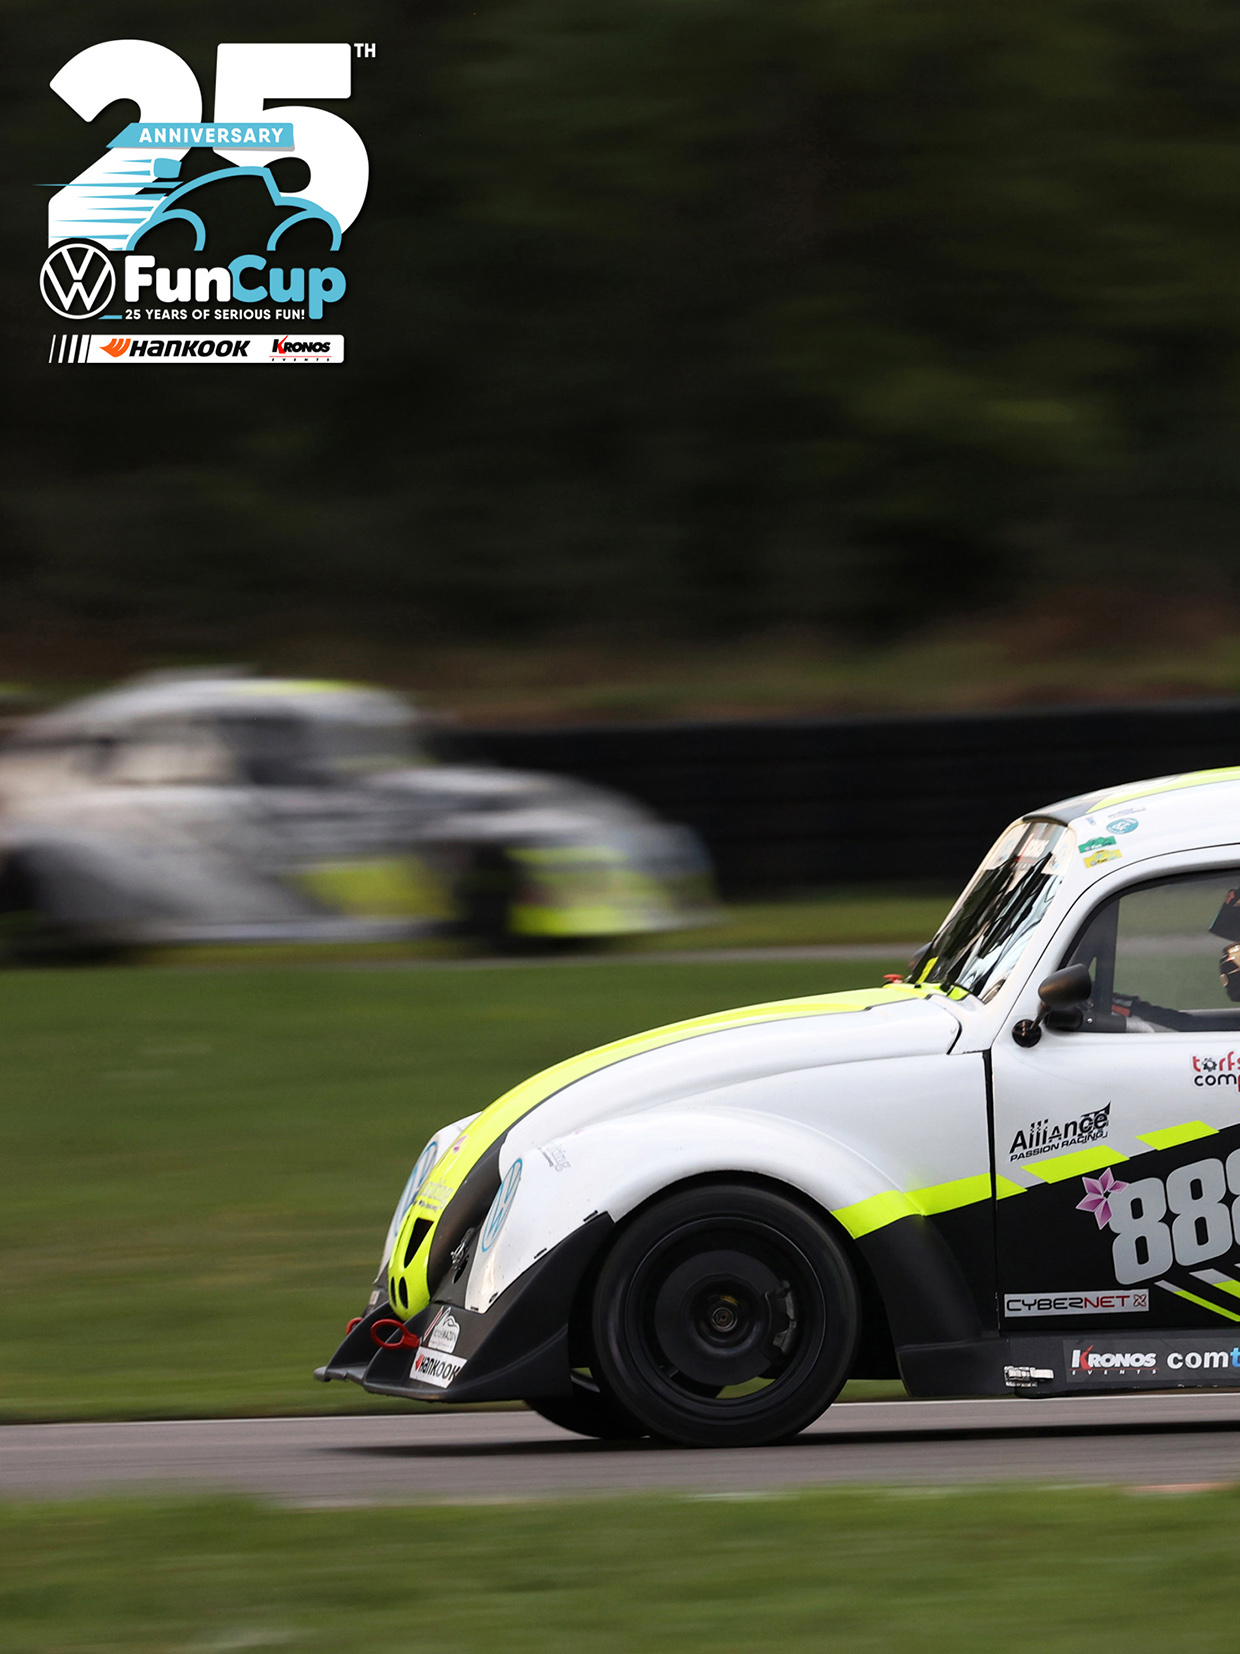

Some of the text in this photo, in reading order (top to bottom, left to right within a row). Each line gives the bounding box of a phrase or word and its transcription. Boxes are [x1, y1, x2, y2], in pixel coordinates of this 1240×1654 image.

[1010, 1130, 1105, 1162] PASSION RACING
[1071, 1345, 1157, 1370] KRONOS
